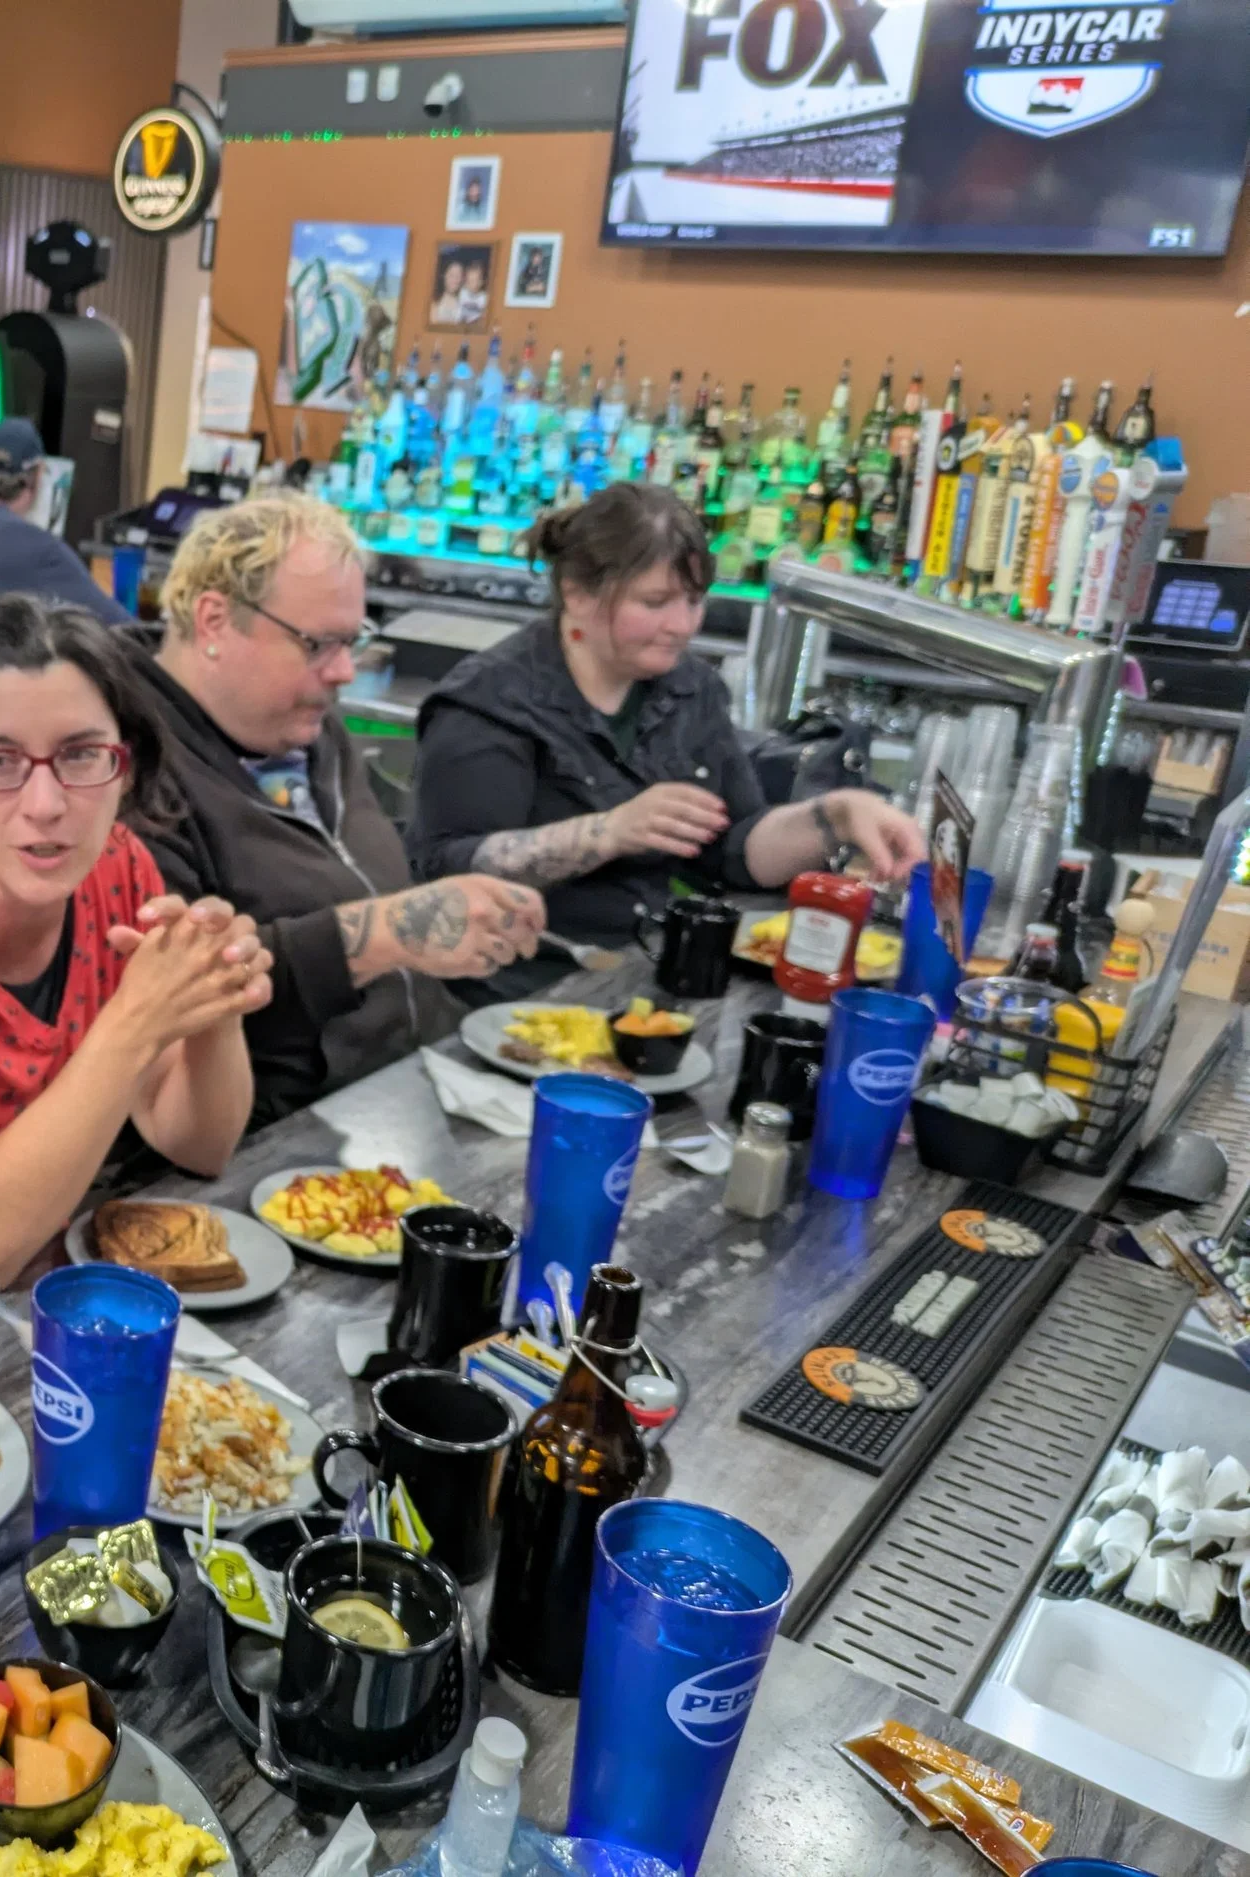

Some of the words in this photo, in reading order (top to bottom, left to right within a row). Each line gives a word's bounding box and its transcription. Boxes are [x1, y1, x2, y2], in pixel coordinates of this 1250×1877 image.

[674, 0, 890, 93] FOX
[975, 8, 1166, 51] INDYCAR
[1007, 42, 1118, 66] SERIES
[1149, 227, 1195, 248] FS1
[35, 1384, 84, 1421] EPSI
